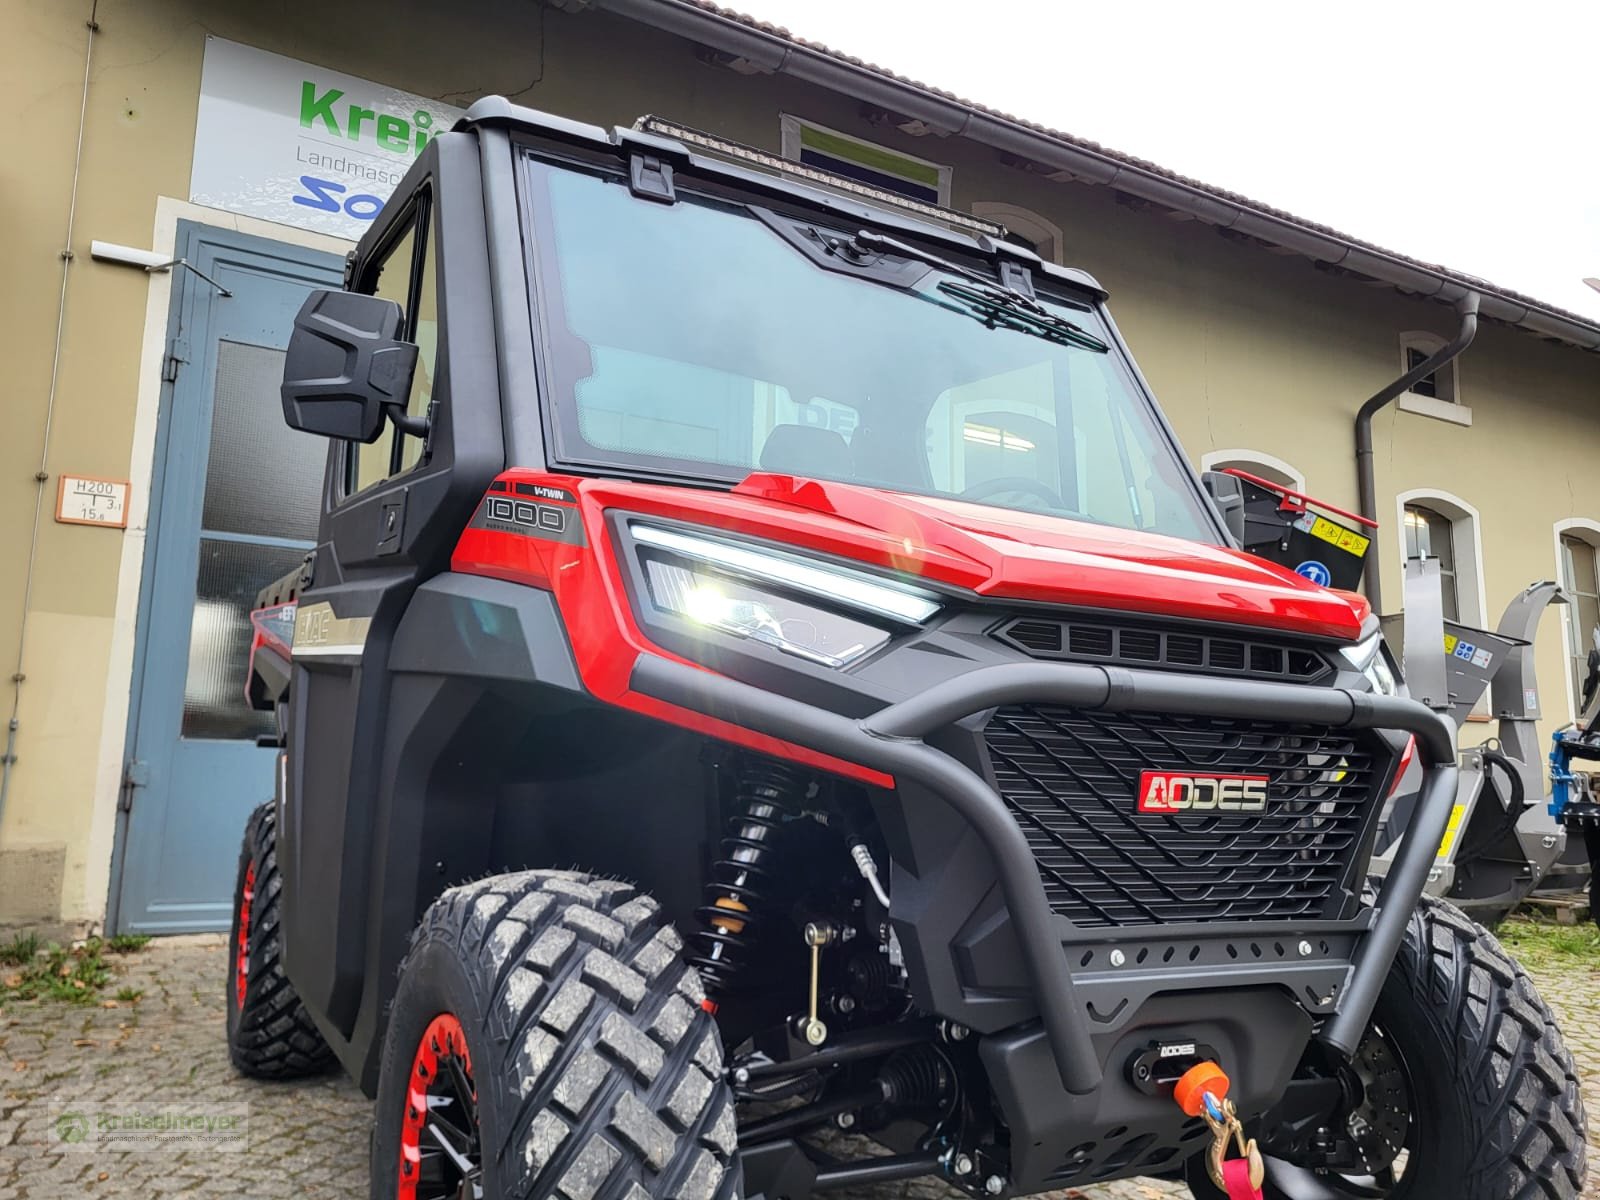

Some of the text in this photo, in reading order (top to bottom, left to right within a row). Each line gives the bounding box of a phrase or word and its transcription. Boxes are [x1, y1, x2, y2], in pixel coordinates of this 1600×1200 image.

[300, 81, 446, 157] Krei
[296, 146, 404, 186] Landmasc
[76, 480, 113, 494] H200
[534, 486, 564, 500] V-TWIN
[487, 497, 565, 533] 1000
[1143, 776, 1267, 811] AODES
[1160, 1044, 1195, 1057] AODES
